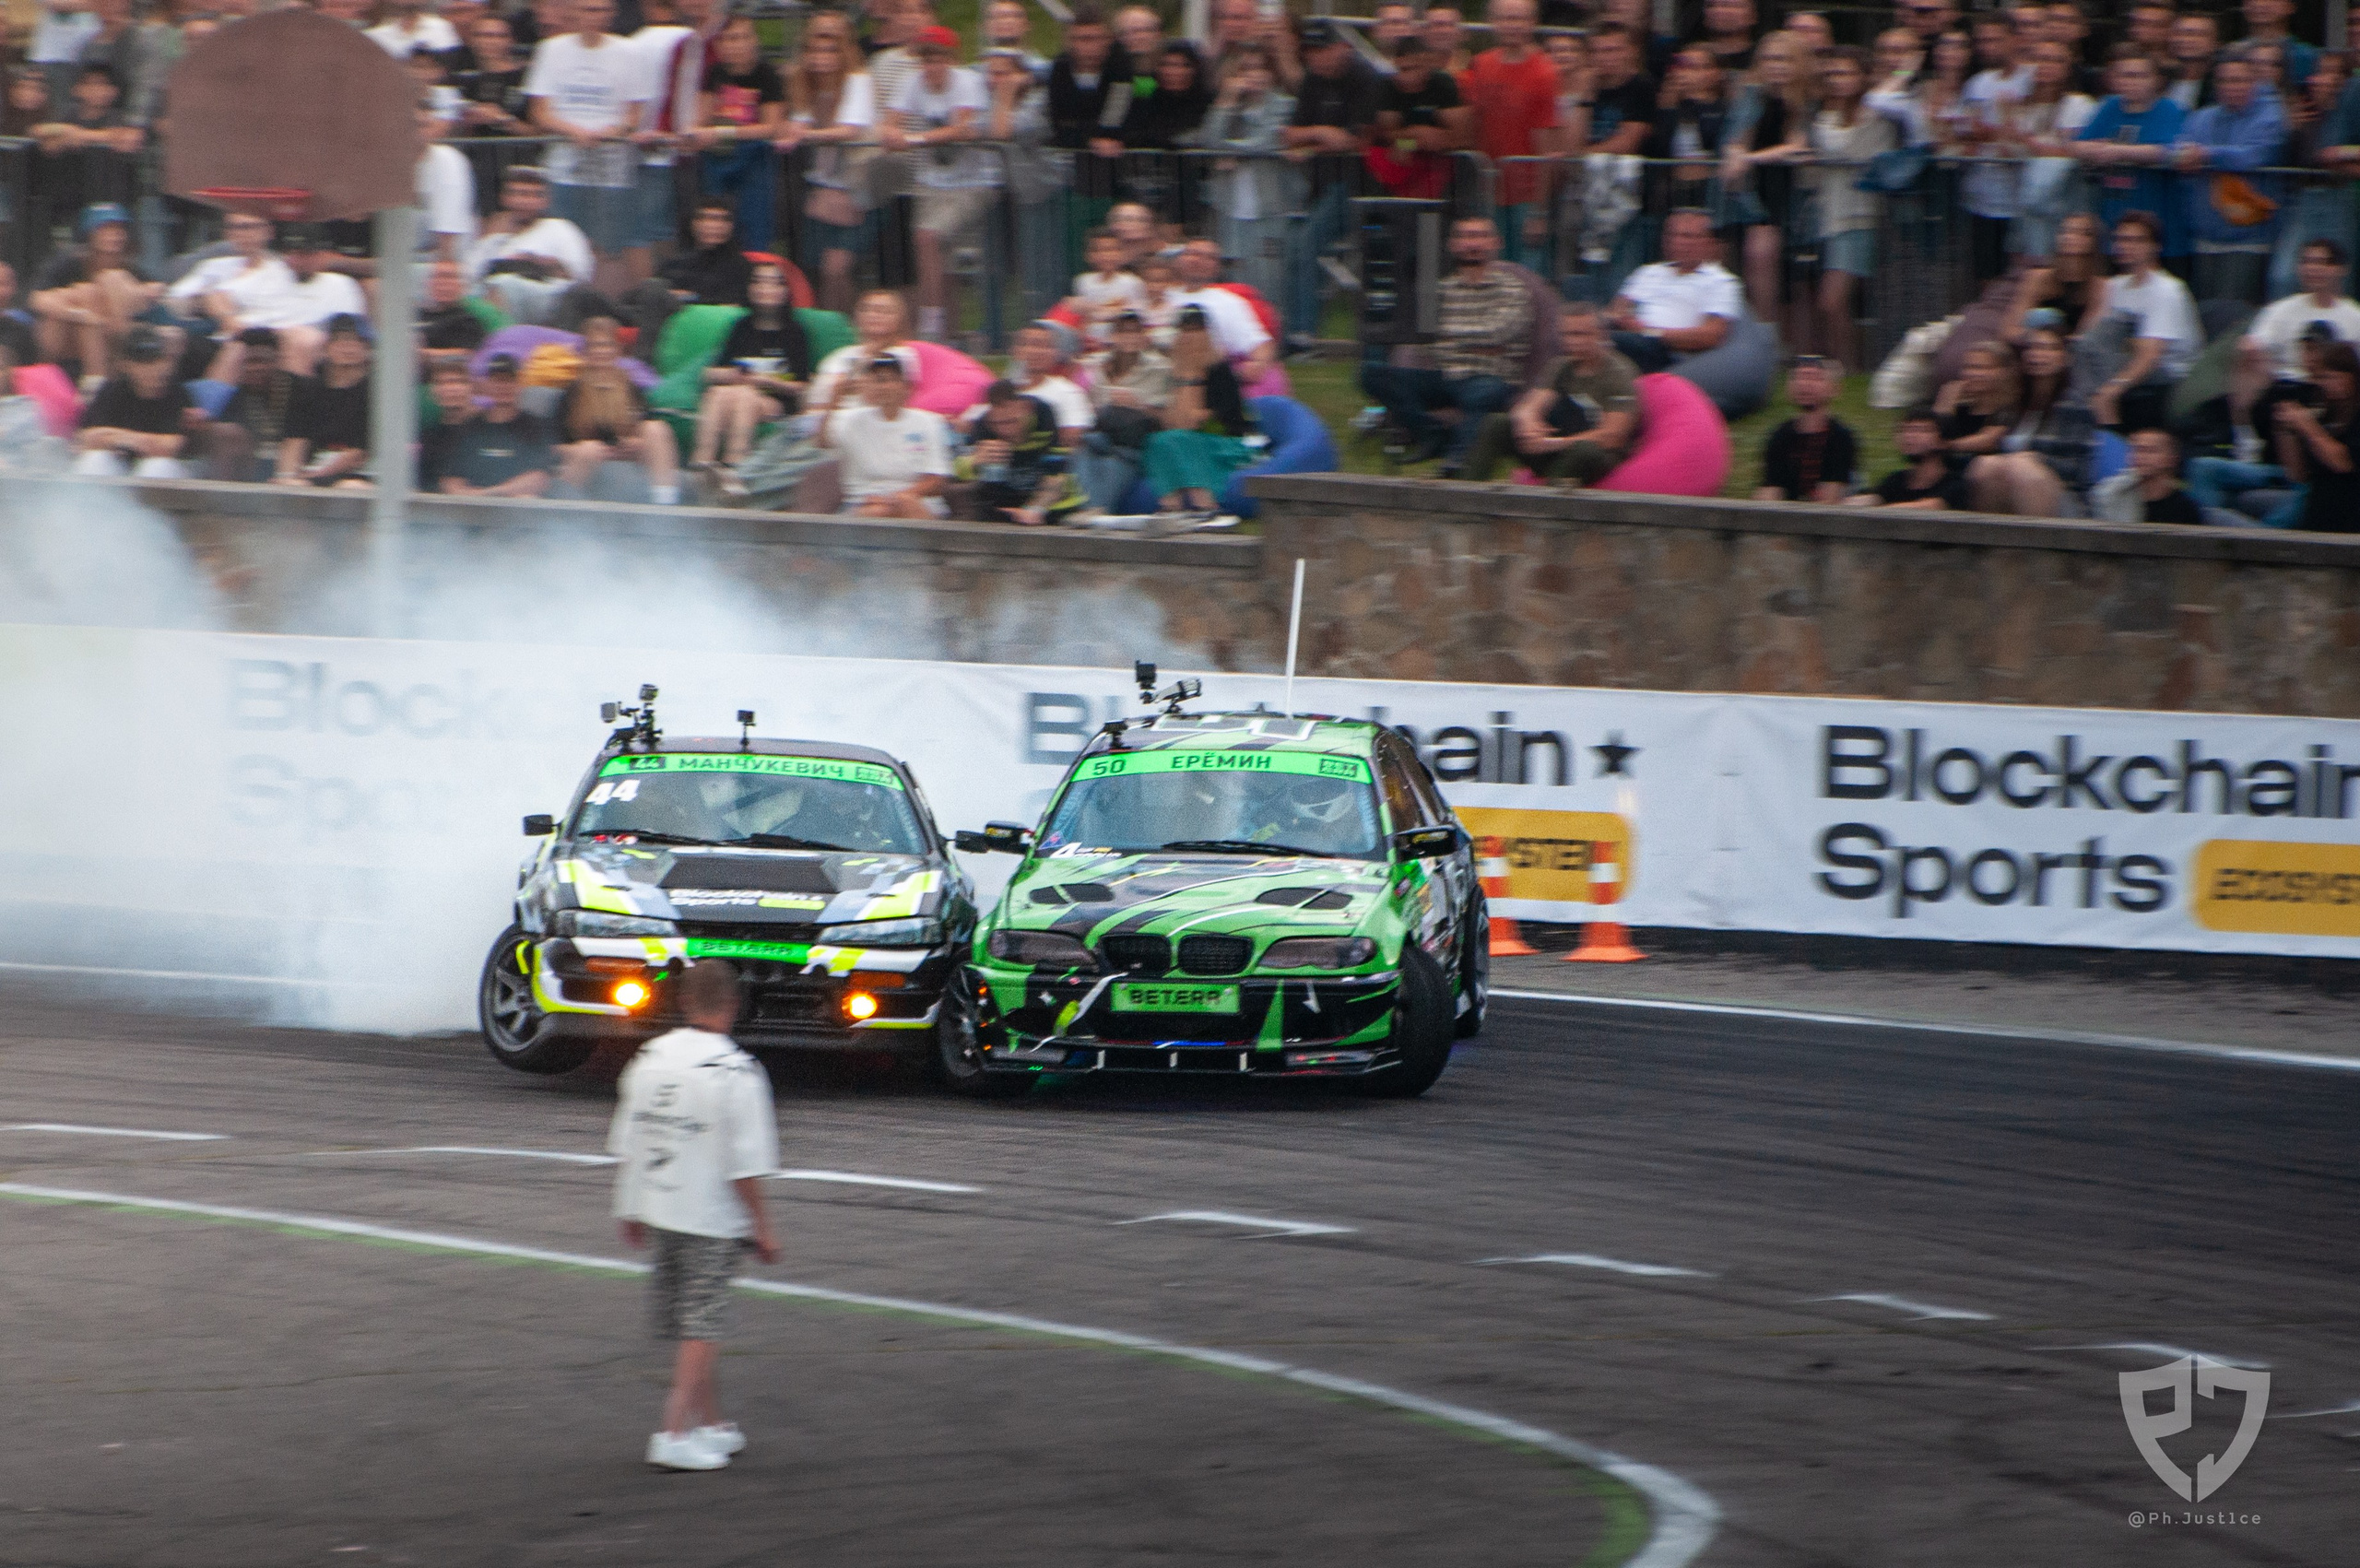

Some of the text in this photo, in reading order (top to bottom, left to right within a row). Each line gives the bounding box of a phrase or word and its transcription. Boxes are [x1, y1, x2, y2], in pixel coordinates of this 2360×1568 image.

[678, 758, 844, 776] МАНЧУКЕВИЧ
[1092, 751, 1271, 776] 50 ЕРЁМИН
[584, 779, 641, 805] 44
[1812, 822, 2172, 919] Sports
